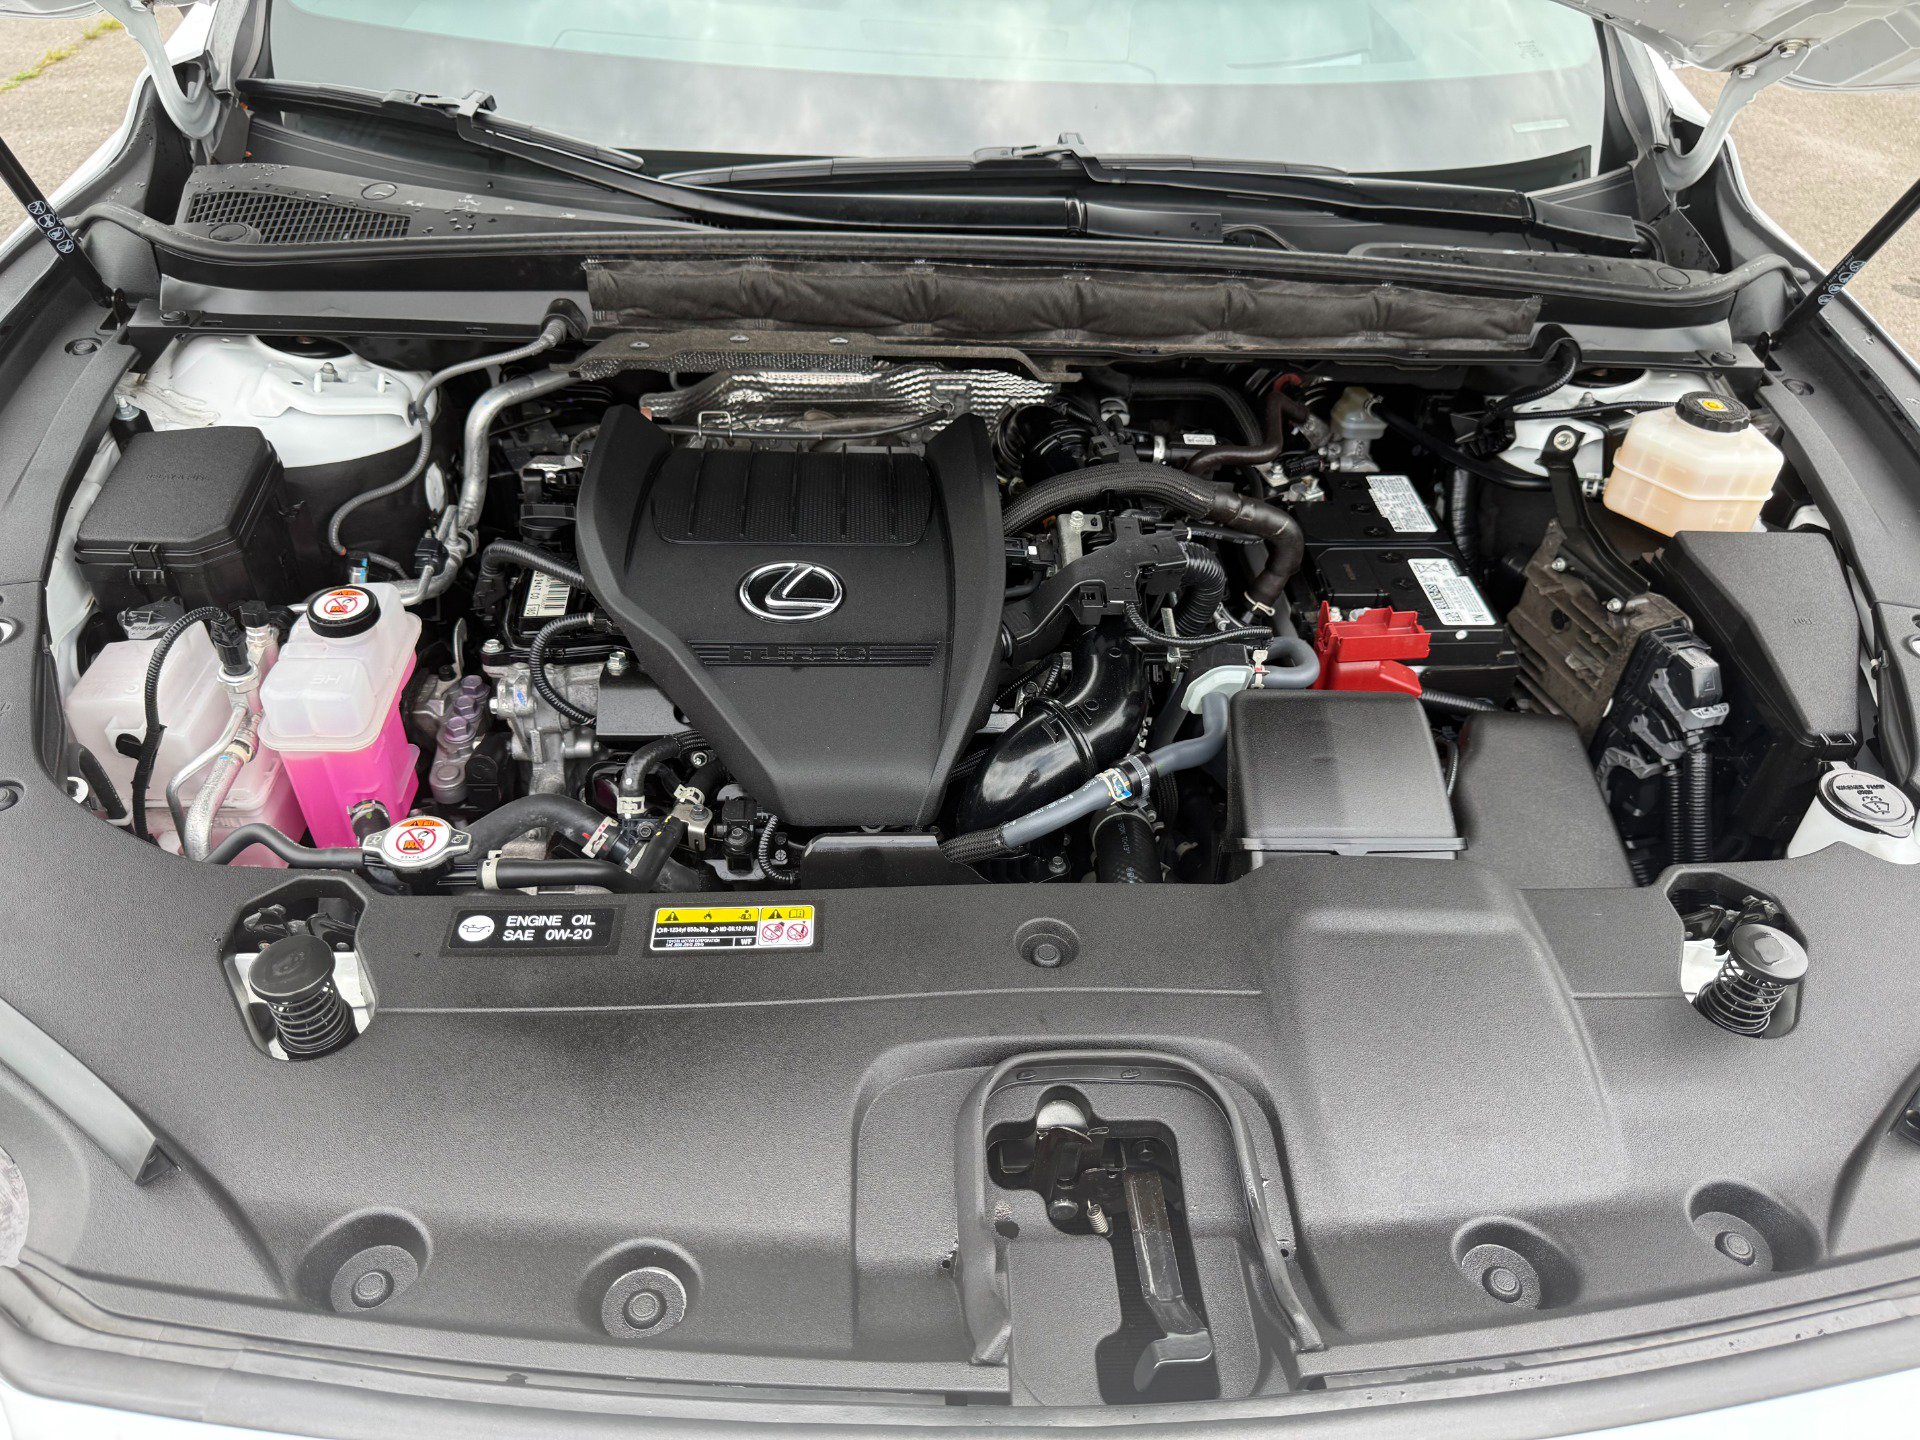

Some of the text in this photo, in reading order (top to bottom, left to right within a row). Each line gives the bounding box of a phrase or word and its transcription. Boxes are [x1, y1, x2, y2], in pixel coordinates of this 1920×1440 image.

[733, 645, 867, 661] TURBO
[506, 914, 596, 927] ENGINE OIL
[502, 929, 593, 941] SAE 0W-20
